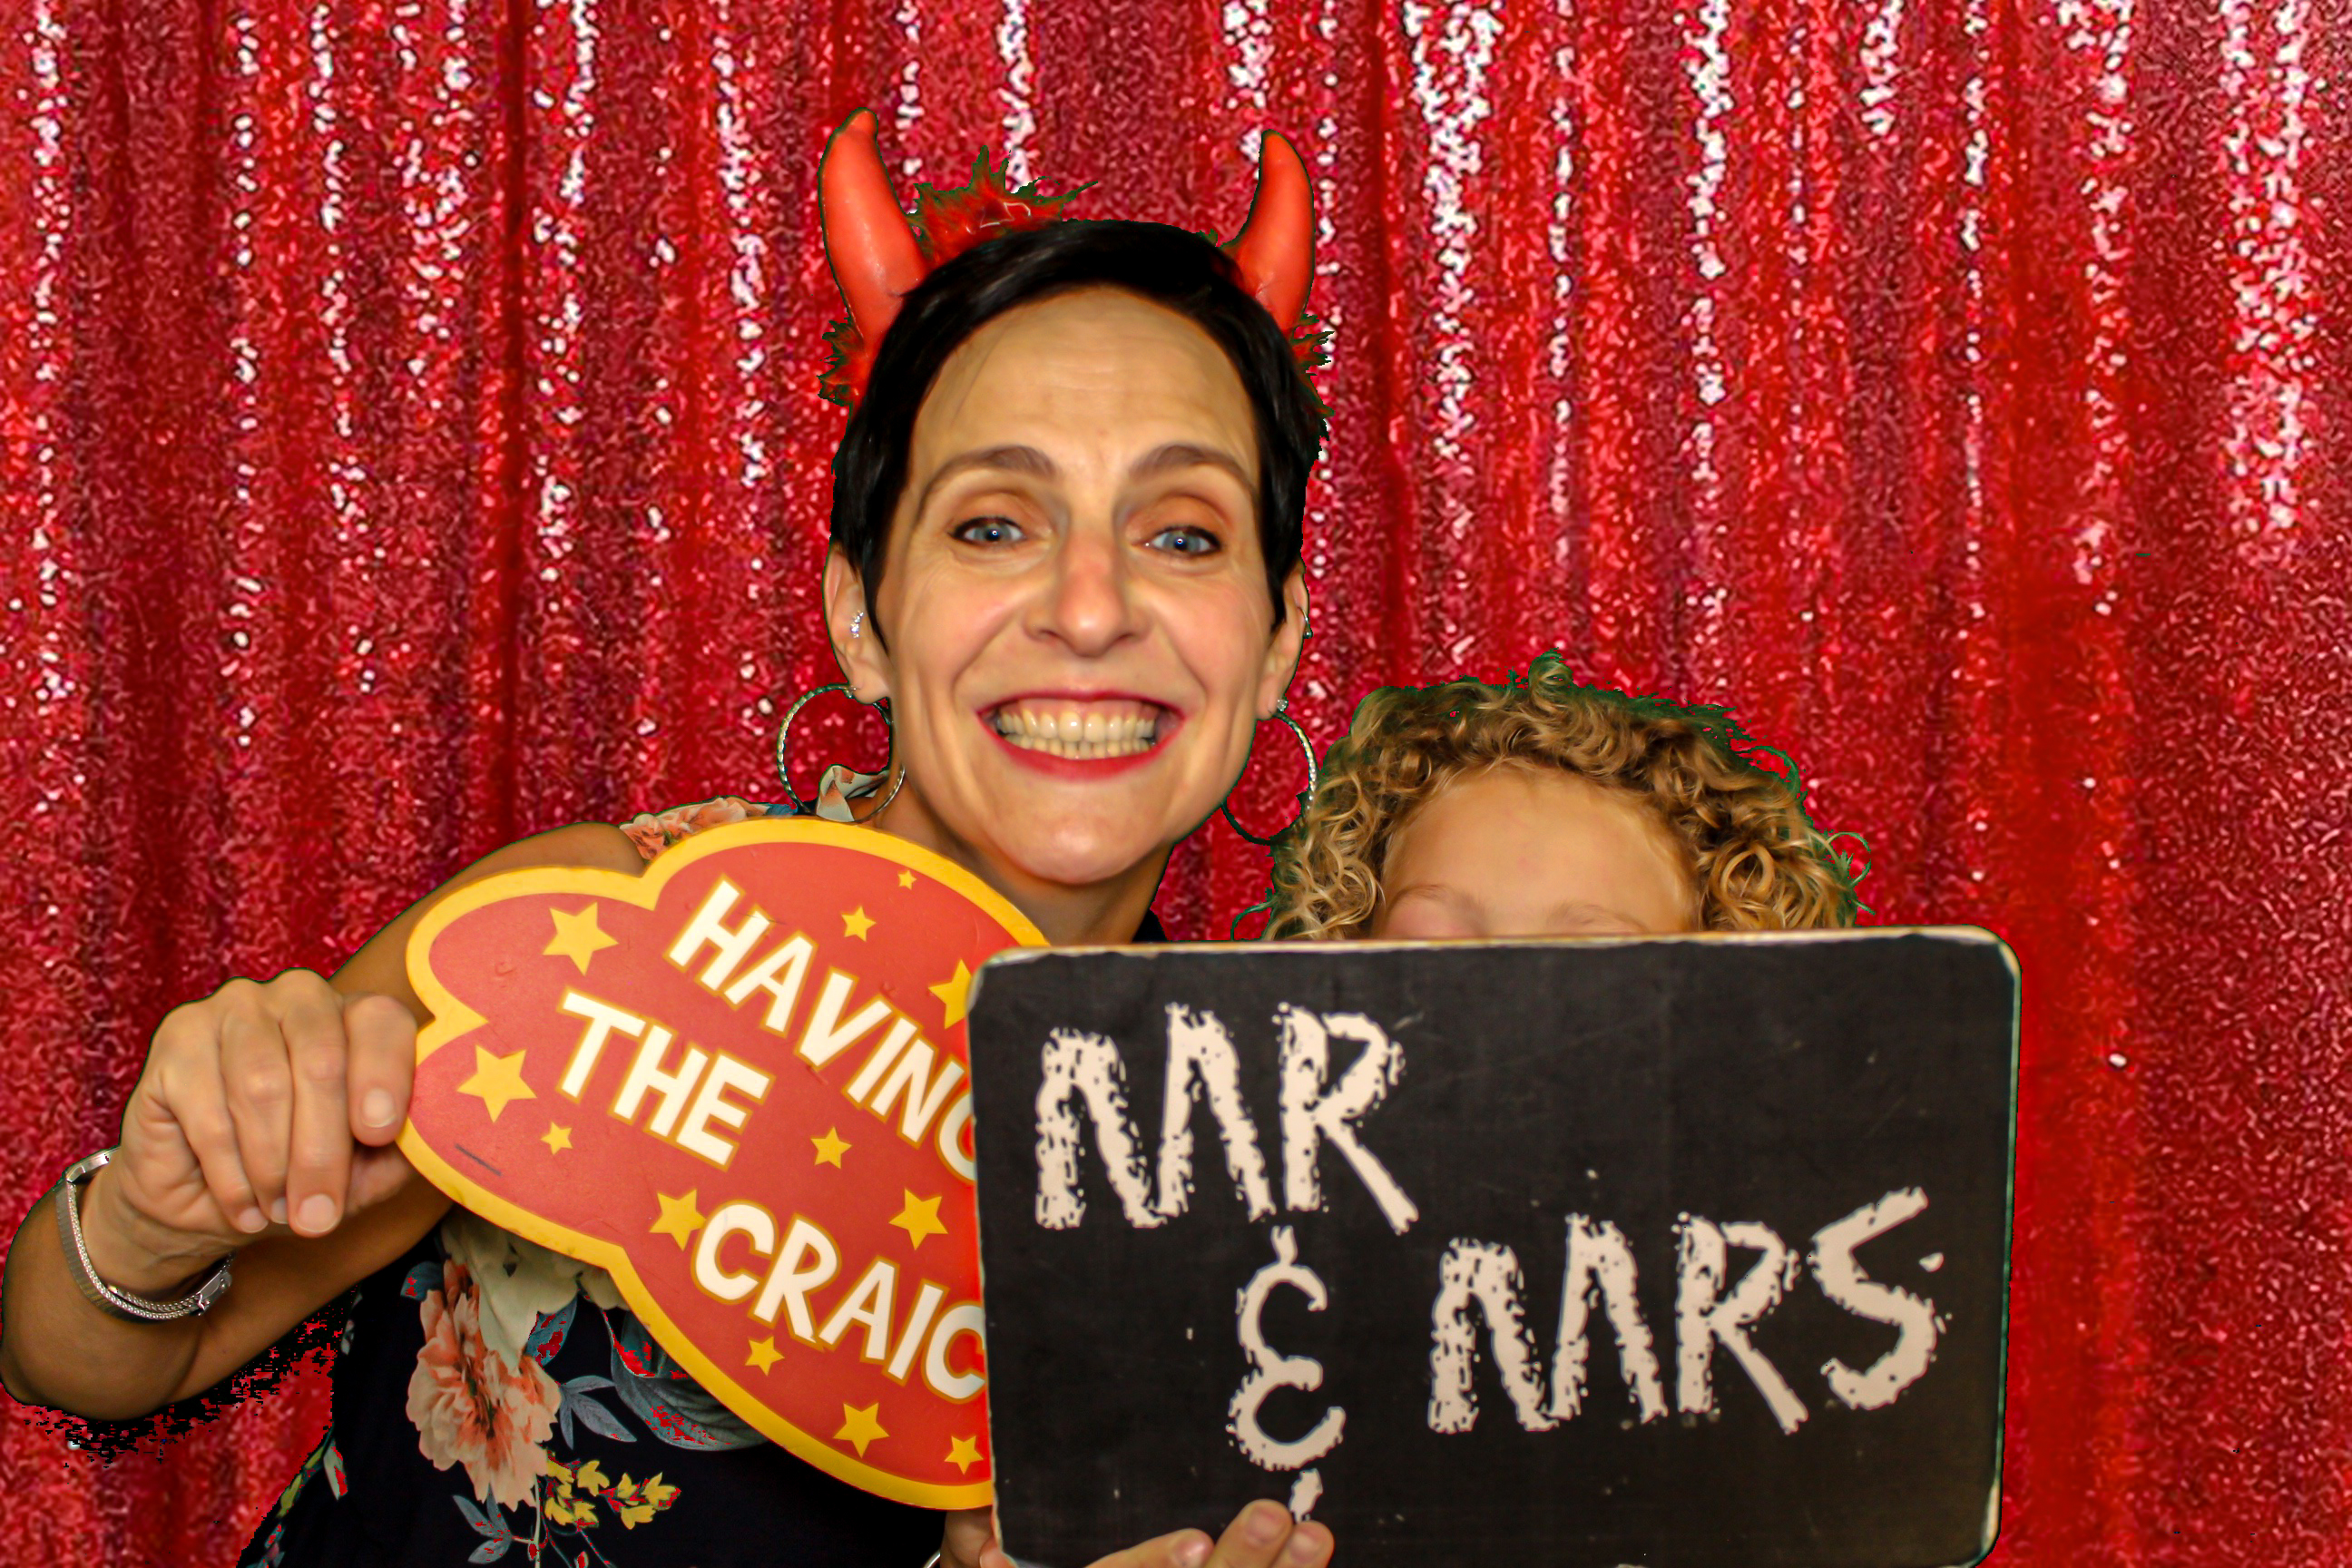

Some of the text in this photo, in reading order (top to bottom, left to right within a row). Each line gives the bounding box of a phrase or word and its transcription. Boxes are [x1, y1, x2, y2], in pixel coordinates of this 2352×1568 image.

[560, 991, 769, 1164] THE
[1035, 1002, 1417, 1234] MR
[695, 1203, 985, 1400] CRAIC
[1229, 1187, 1945, 1523] & MRS
